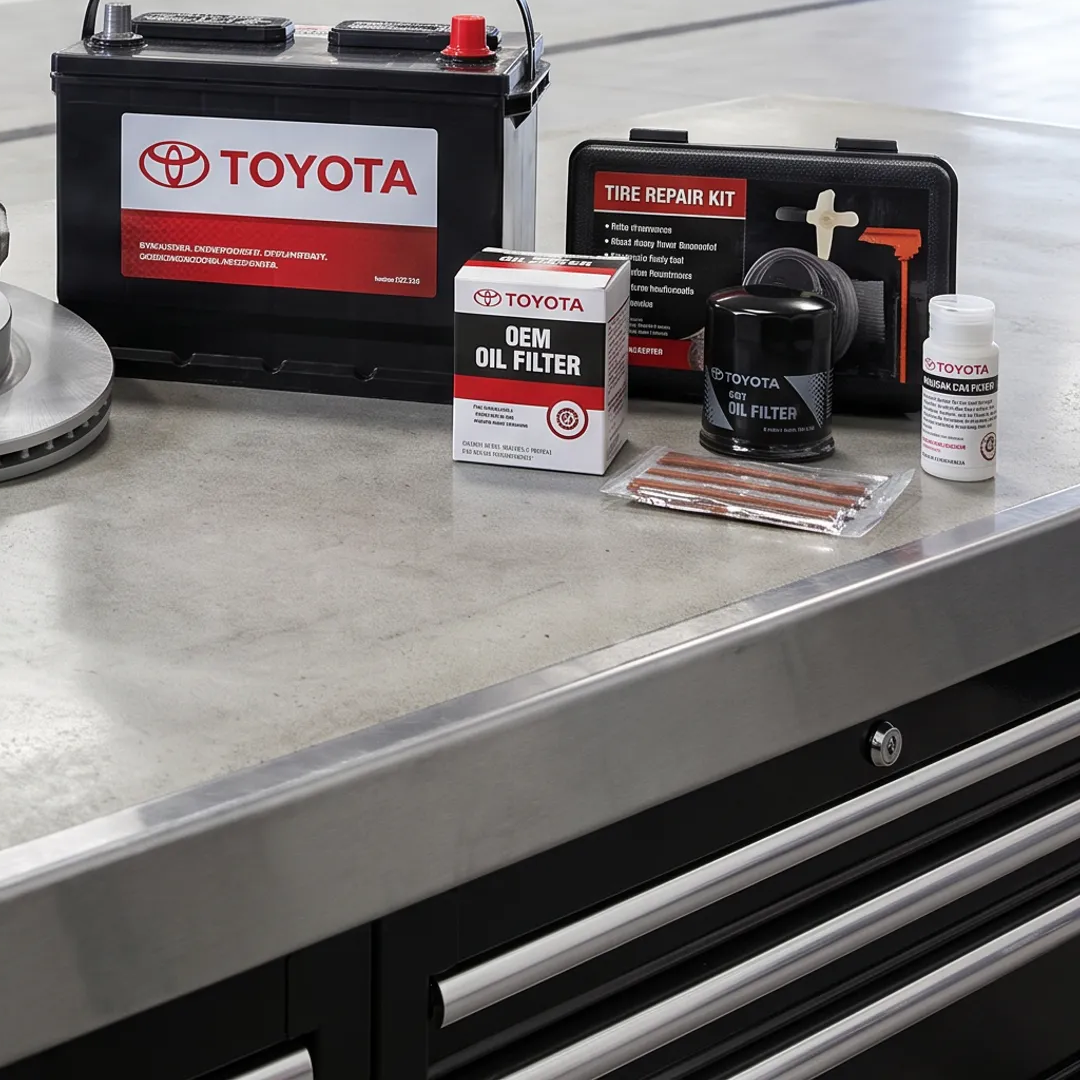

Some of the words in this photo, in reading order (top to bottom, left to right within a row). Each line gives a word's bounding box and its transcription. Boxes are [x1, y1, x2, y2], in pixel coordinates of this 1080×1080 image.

[220, 149, 418, 196] TOYOTA
[605, 184, 641, 202] TIRE
[645, 186, 703, 206] REPAIR
[708, 190, 736, 207] KIT
[505, 292, 585, 312] TOYOTA
[505, 325, 551, 350] OEM
[475, 346, 507, 370] OIL
[513, 349, 581, 377] FILTER
[936, 361, 989, 376] TOYOTA
[725, 371, 780, 390] TOYOTA
[728, 401, 748, 417] OIL
[750, 404, 798, 420] FILTER
